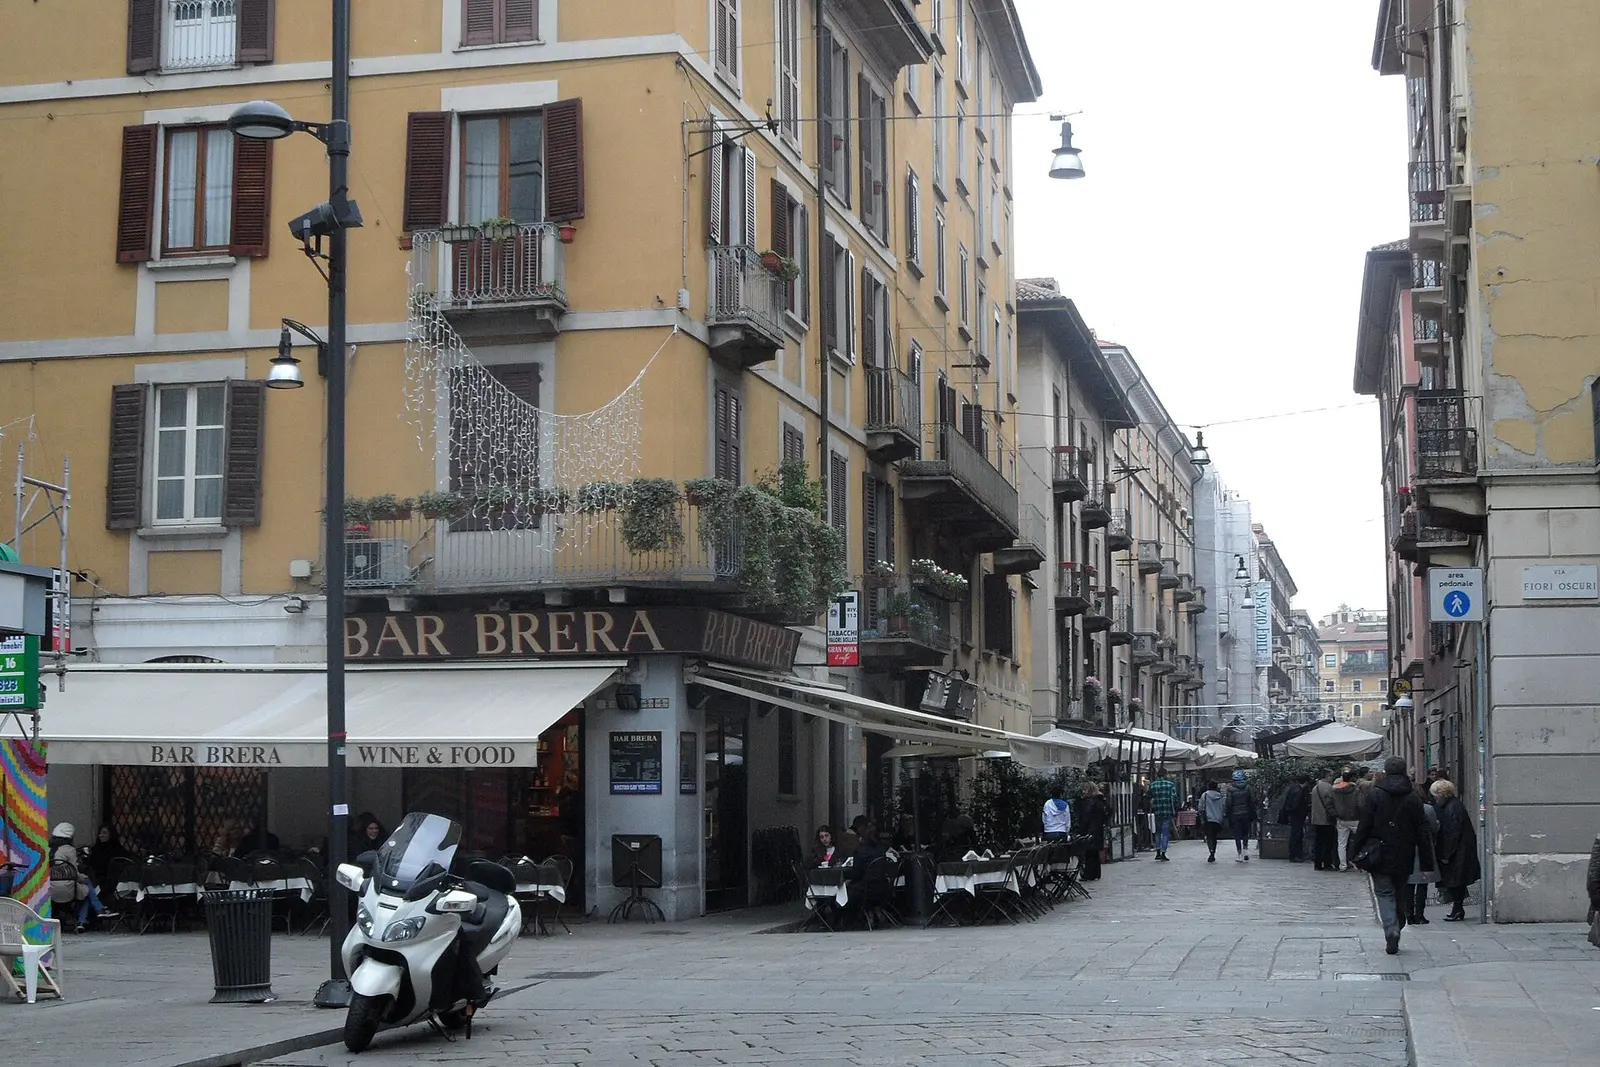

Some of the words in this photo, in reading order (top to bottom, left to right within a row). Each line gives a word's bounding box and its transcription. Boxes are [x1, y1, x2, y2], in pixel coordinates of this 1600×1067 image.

[1439, 580, 1474, 588] pedonale
[1524, 582, 1553, 591] FIORI
[1558, 582, 1596, 590] OSCURI
[832, 596, 854, 628] T
[1256, 592, 1269, 625] SPAZIO
[344, 614, 451, 657] BAR
[474, 610, 665, 655] BRERA
[702, 612, 742, 657] BAR
[1256, 628, 1270, 654] EDILE
[5, 657, 16, 669] 16
[150, 745, 195, 763] BAR
[206, 746, 282, 764] BRERA
[357, 745, 419, 764] WINE
[426, 746, 443, 764] &
[450, 746, 515, 764] FOOD
